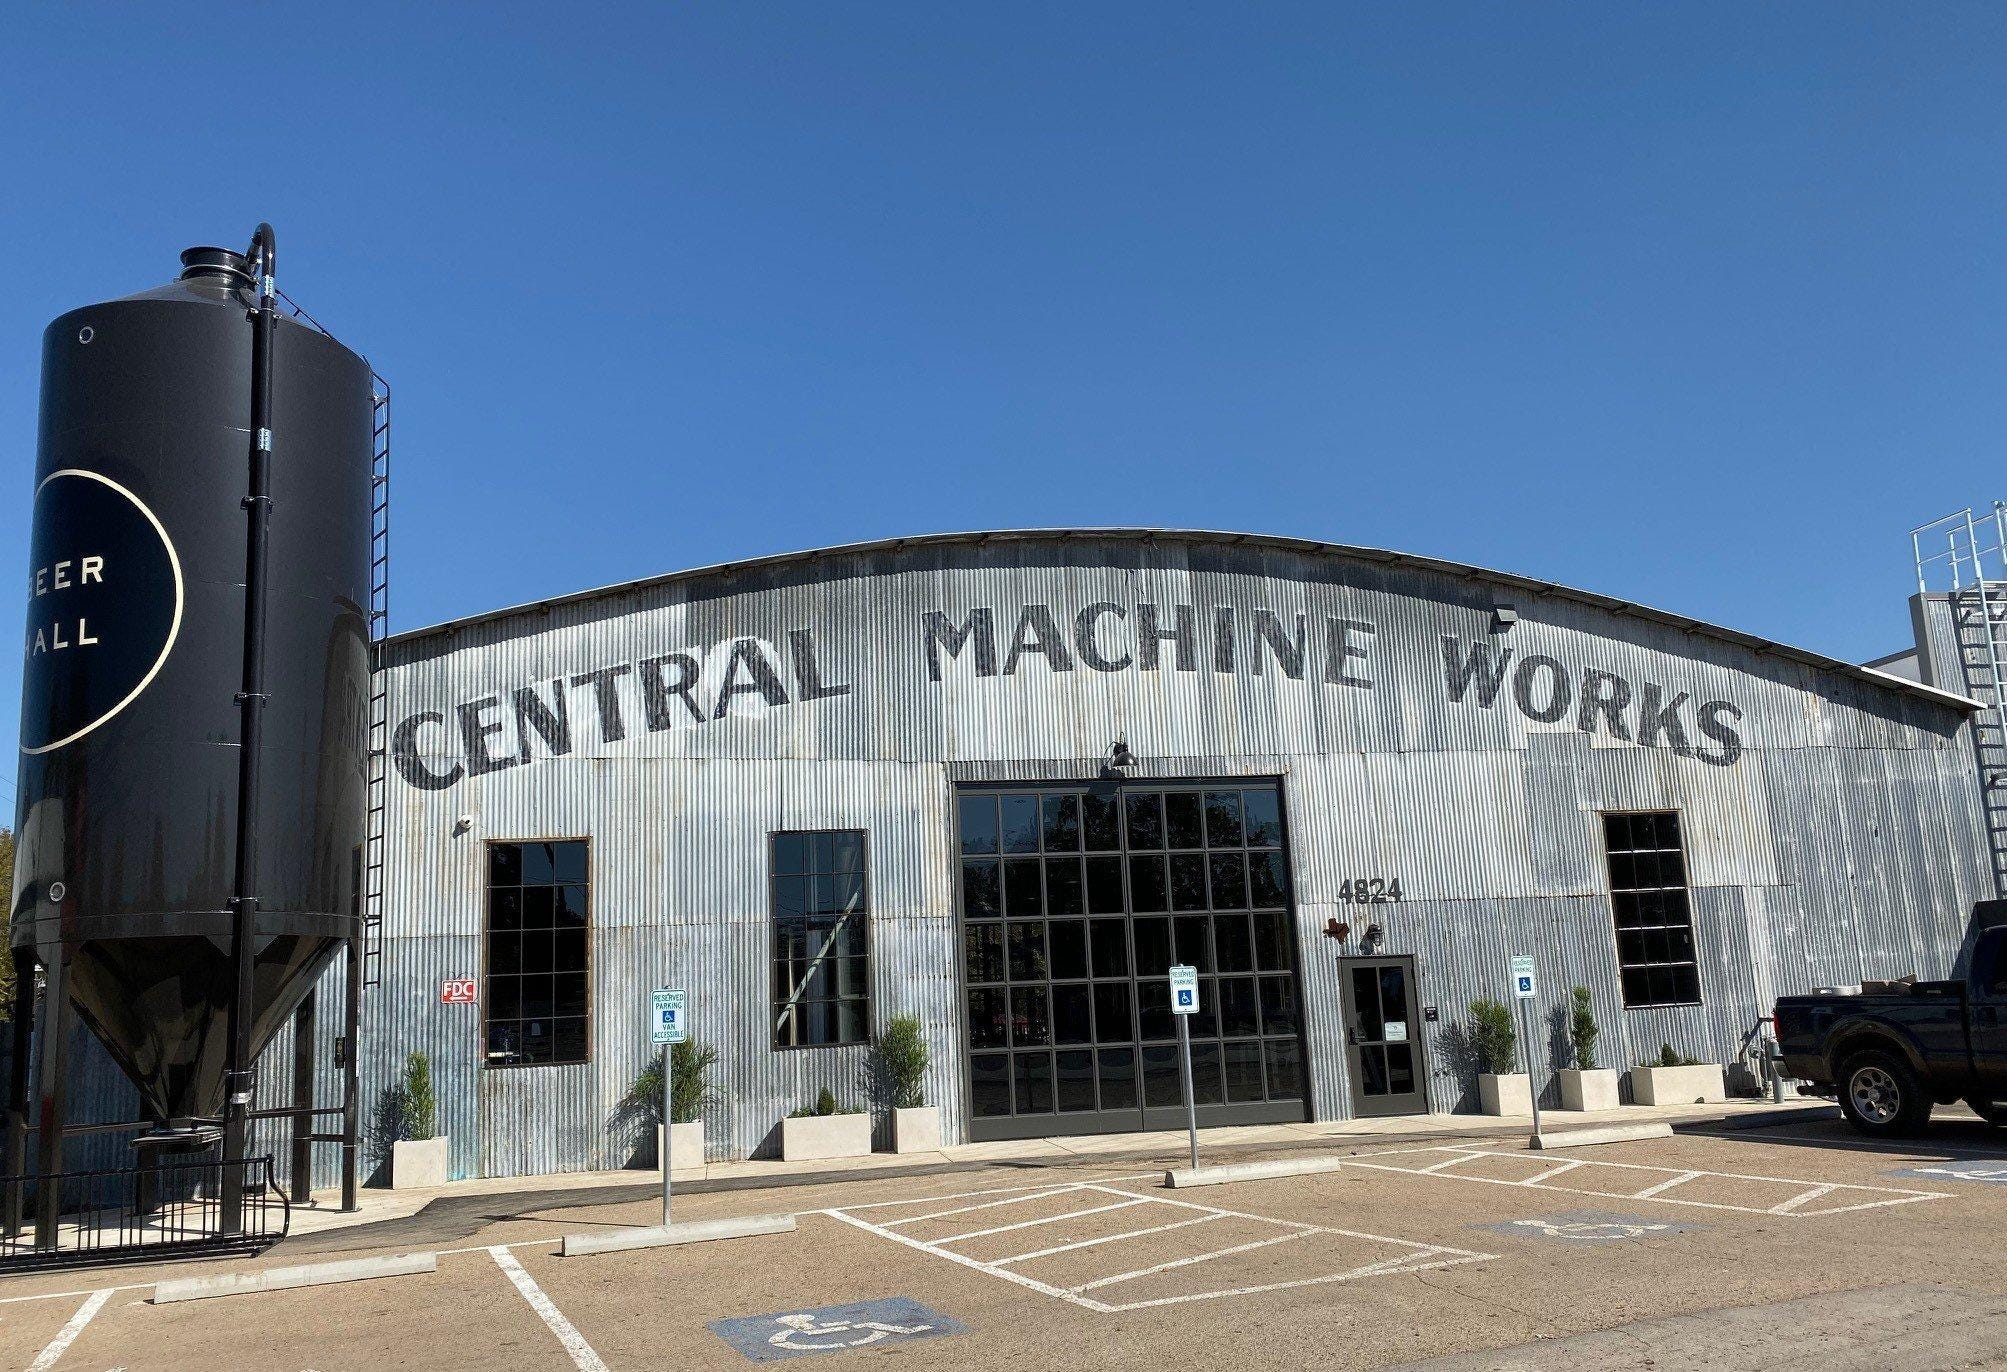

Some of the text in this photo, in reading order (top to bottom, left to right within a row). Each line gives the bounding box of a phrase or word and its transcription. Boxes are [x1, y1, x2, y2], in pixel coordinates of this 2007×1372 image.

[29, 555, 104, 602] EER
[25, 617, 99, 660] ALL
[392, 601, 1744, 791] CENTRAL MACHINE WORKS
[1338, 877, 1403, 905] 4824
[443, 982, 474, 997] FDC
[653, 993, 684, 1002] RESERVED
[655, 1002, 683, 1010] PARKING
[653, 1030, 684, 1039] ACCESSIBLE
[662, 1023, 676, 1031] VAN
